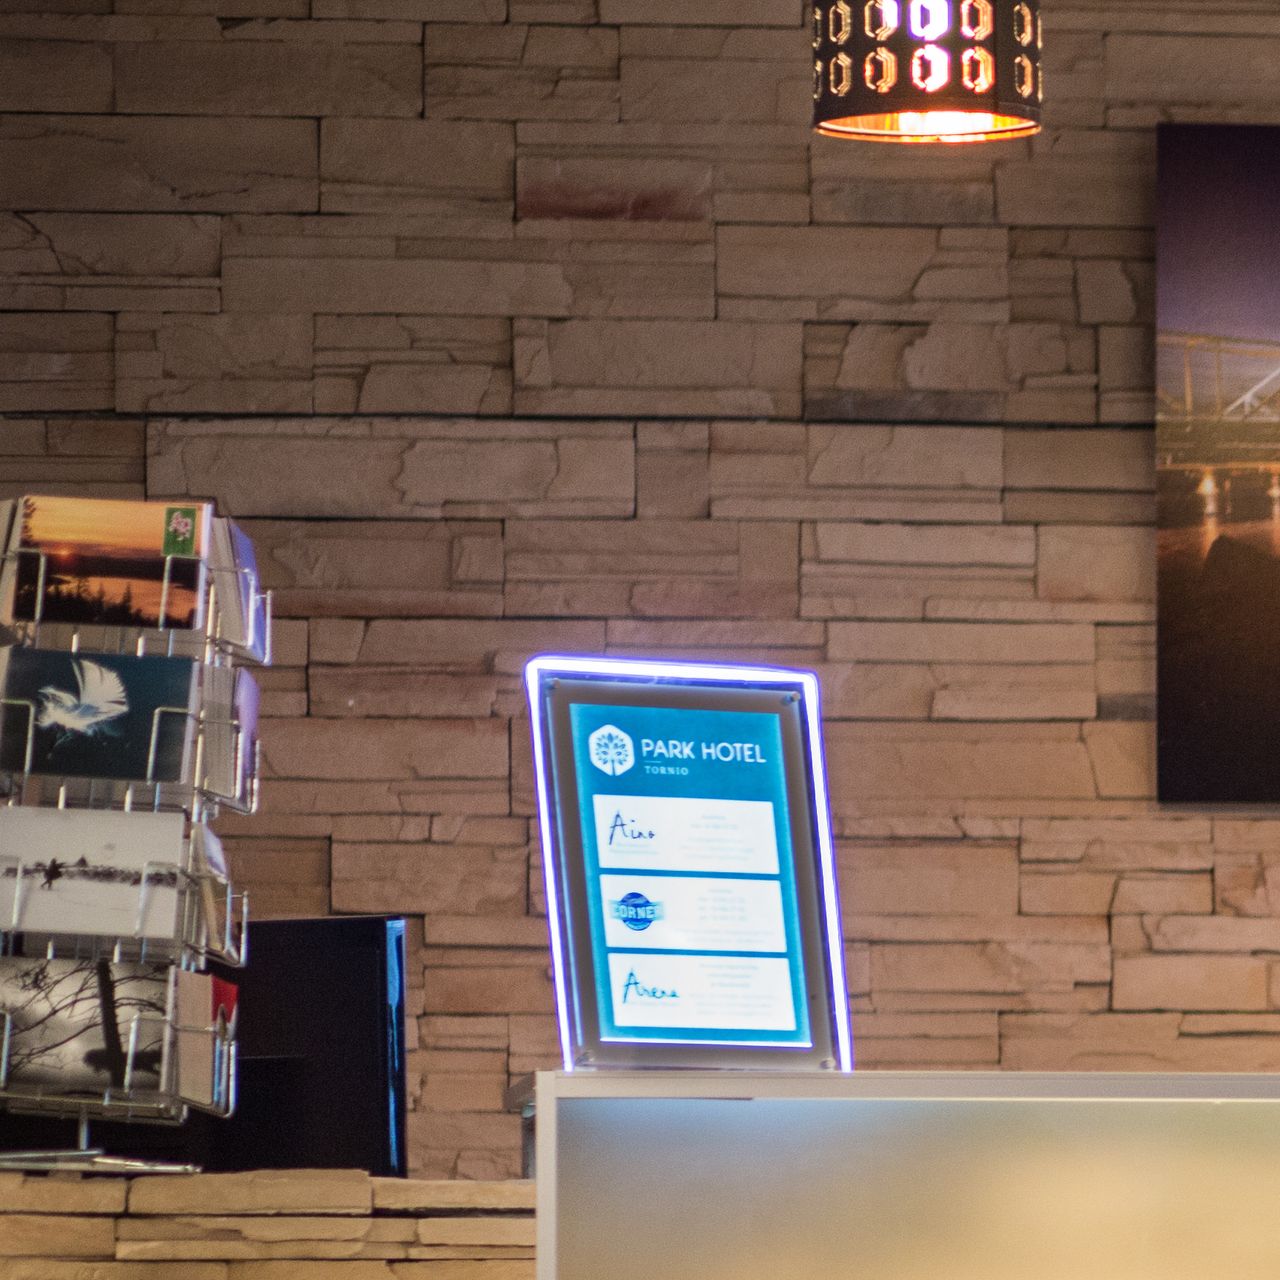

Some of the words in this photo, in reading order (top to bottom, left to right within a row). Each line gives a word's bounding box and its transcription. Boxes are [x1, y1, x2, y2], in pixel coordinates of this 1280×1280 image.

[641, 738, 695, 760] PARK
[701, 741, 767, 763] HOTEL
[643, 765, 689, 776] TORNIO
